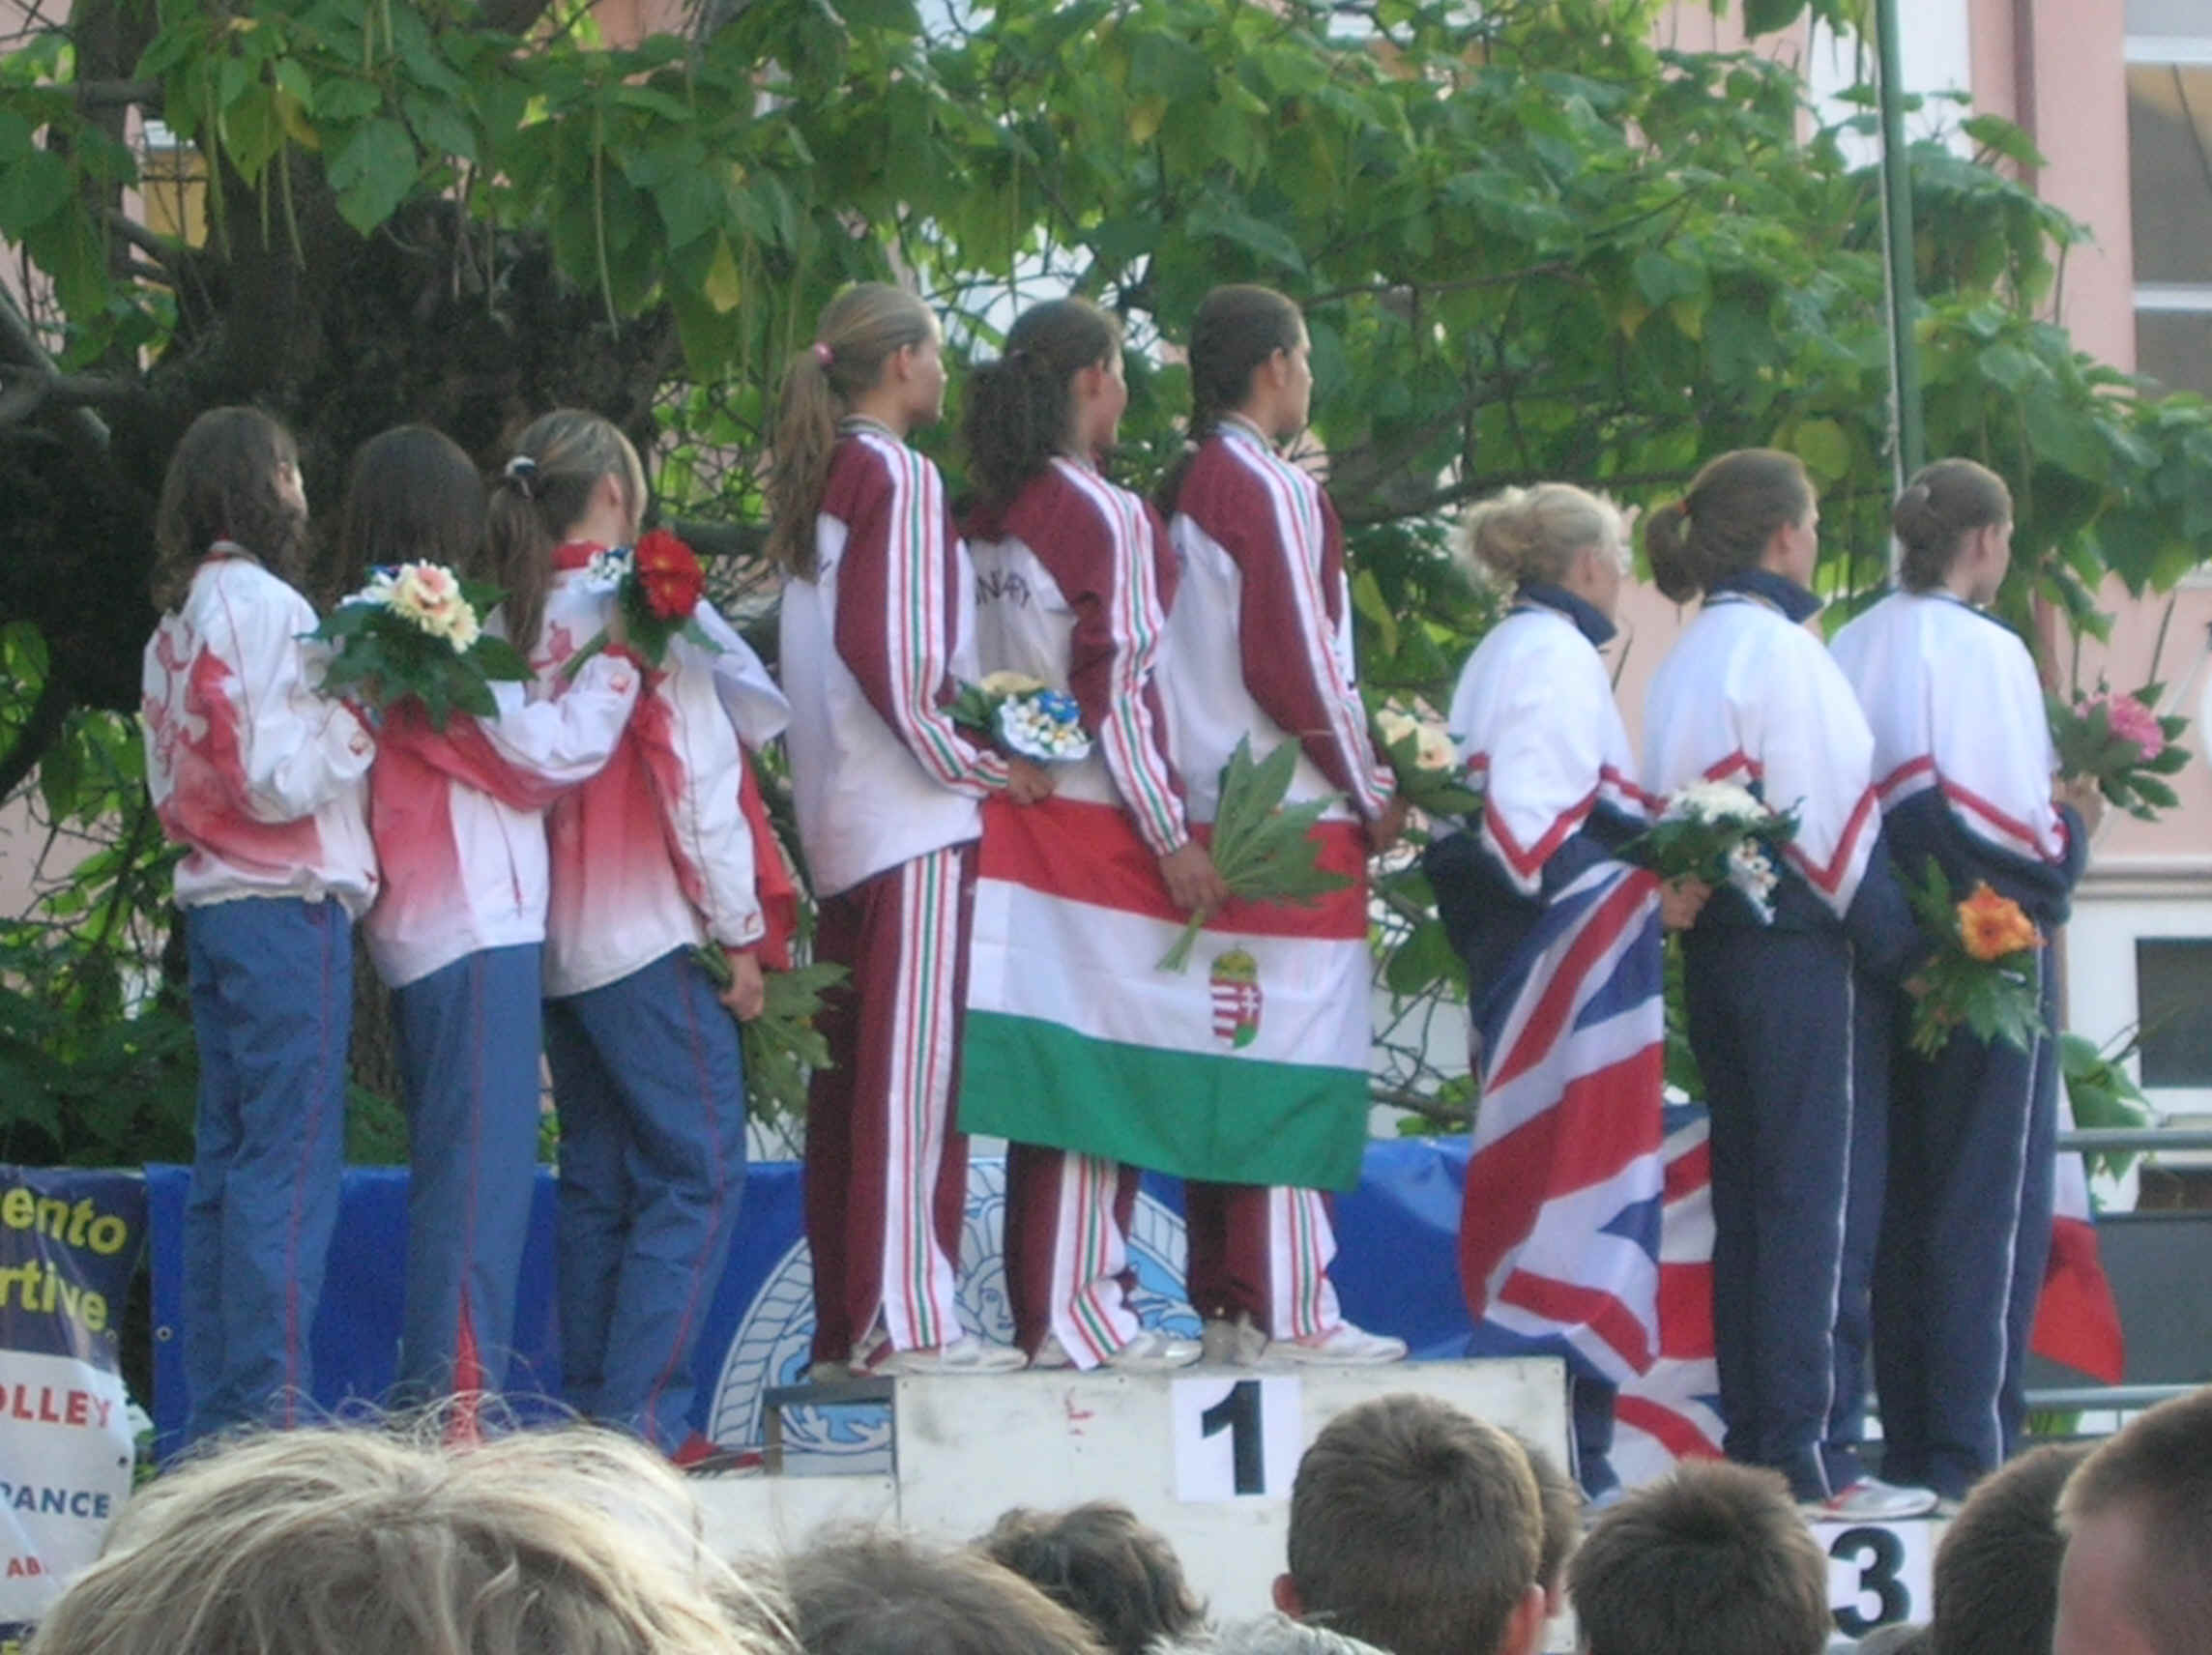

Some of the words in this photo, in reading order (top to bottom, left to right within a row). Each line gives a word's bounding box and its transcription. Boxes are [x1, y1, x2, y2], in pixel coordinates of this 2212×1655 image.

[2, 1187, 128, 1254] ento
[1201, 1379, 1266, 1495] 1
[1828, 1526, 1911, 1640] 3
